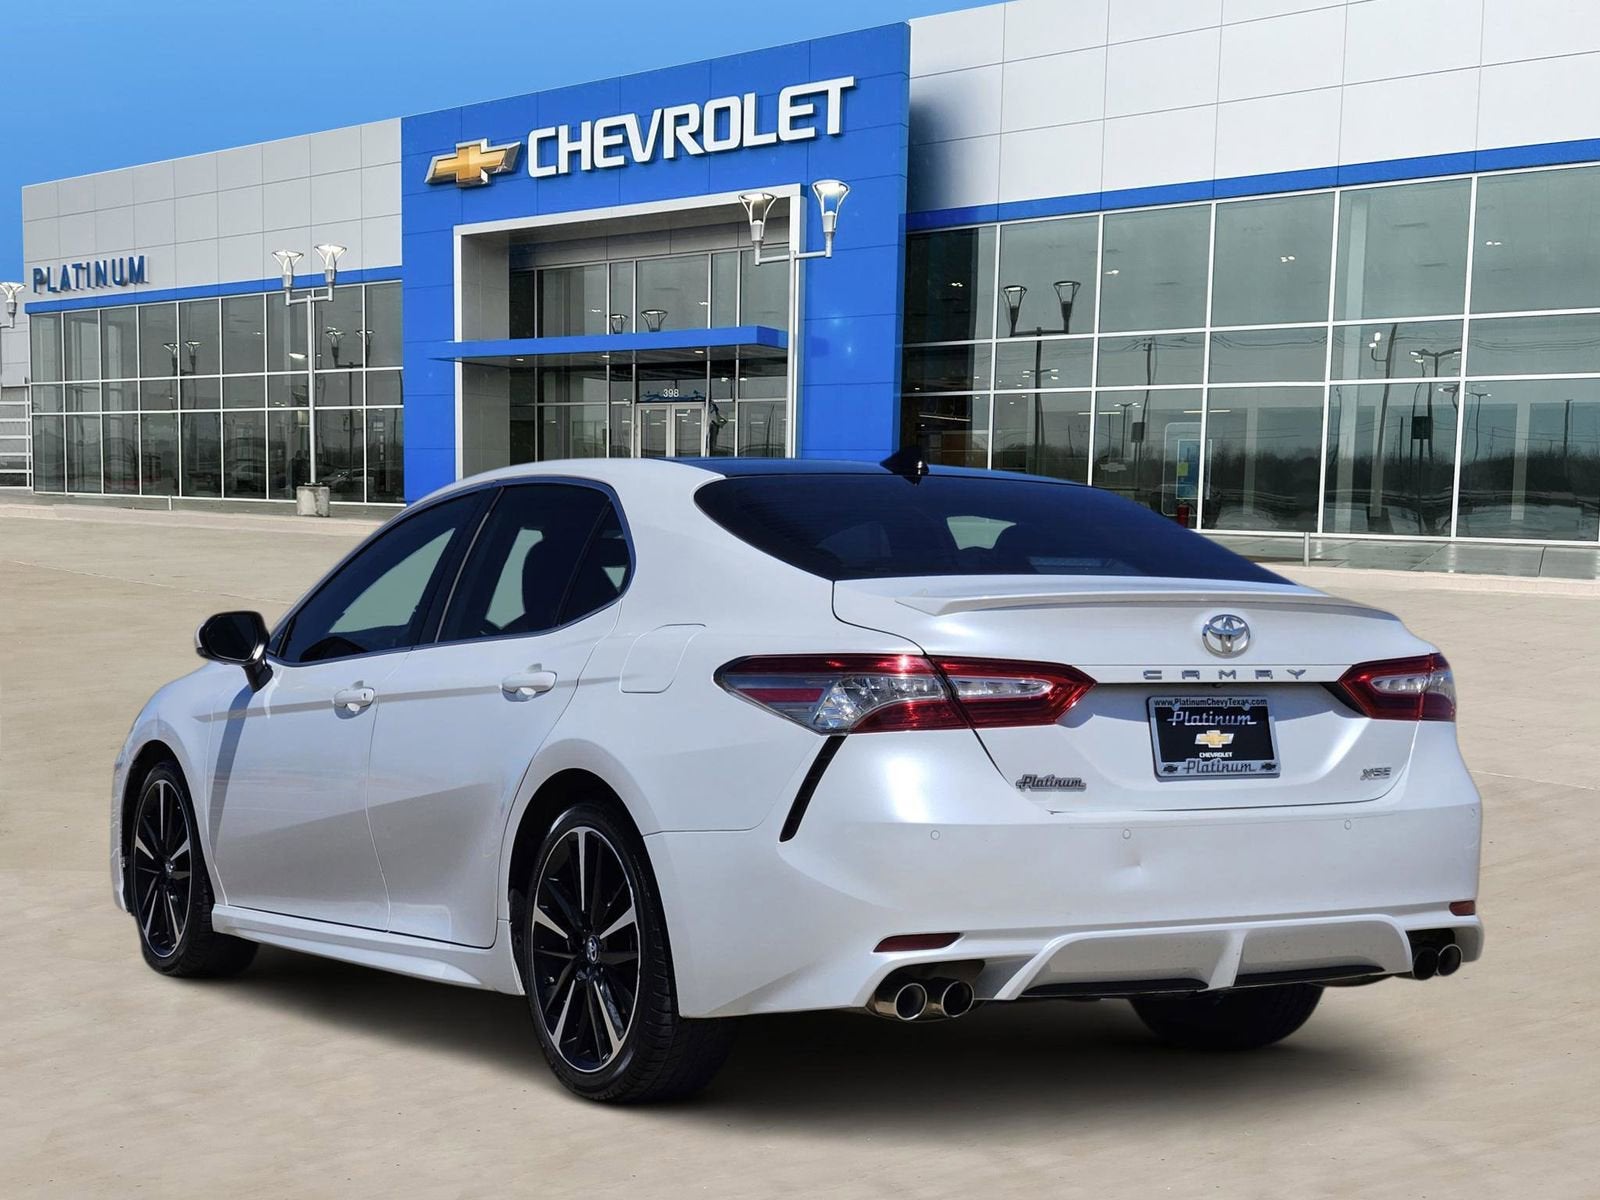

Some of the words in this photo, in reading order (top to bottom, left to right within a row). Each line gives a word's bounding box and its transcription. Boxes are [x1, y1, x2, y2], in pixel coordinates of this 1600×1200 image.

[527, 76, 856, 178] CHEVROLET
[32, 255, 147, 294] PLATINUM
[663, 388, 680, 398] 398
[1142, 669, 1307, 680] CAMRY
[1166, 711, 1257, 726] Platinum
[1183, 759, 1257, 774] Platinum
[1360, 767, 1392, 780] XSE
[1015, 774, 1087, 792] Platinum
